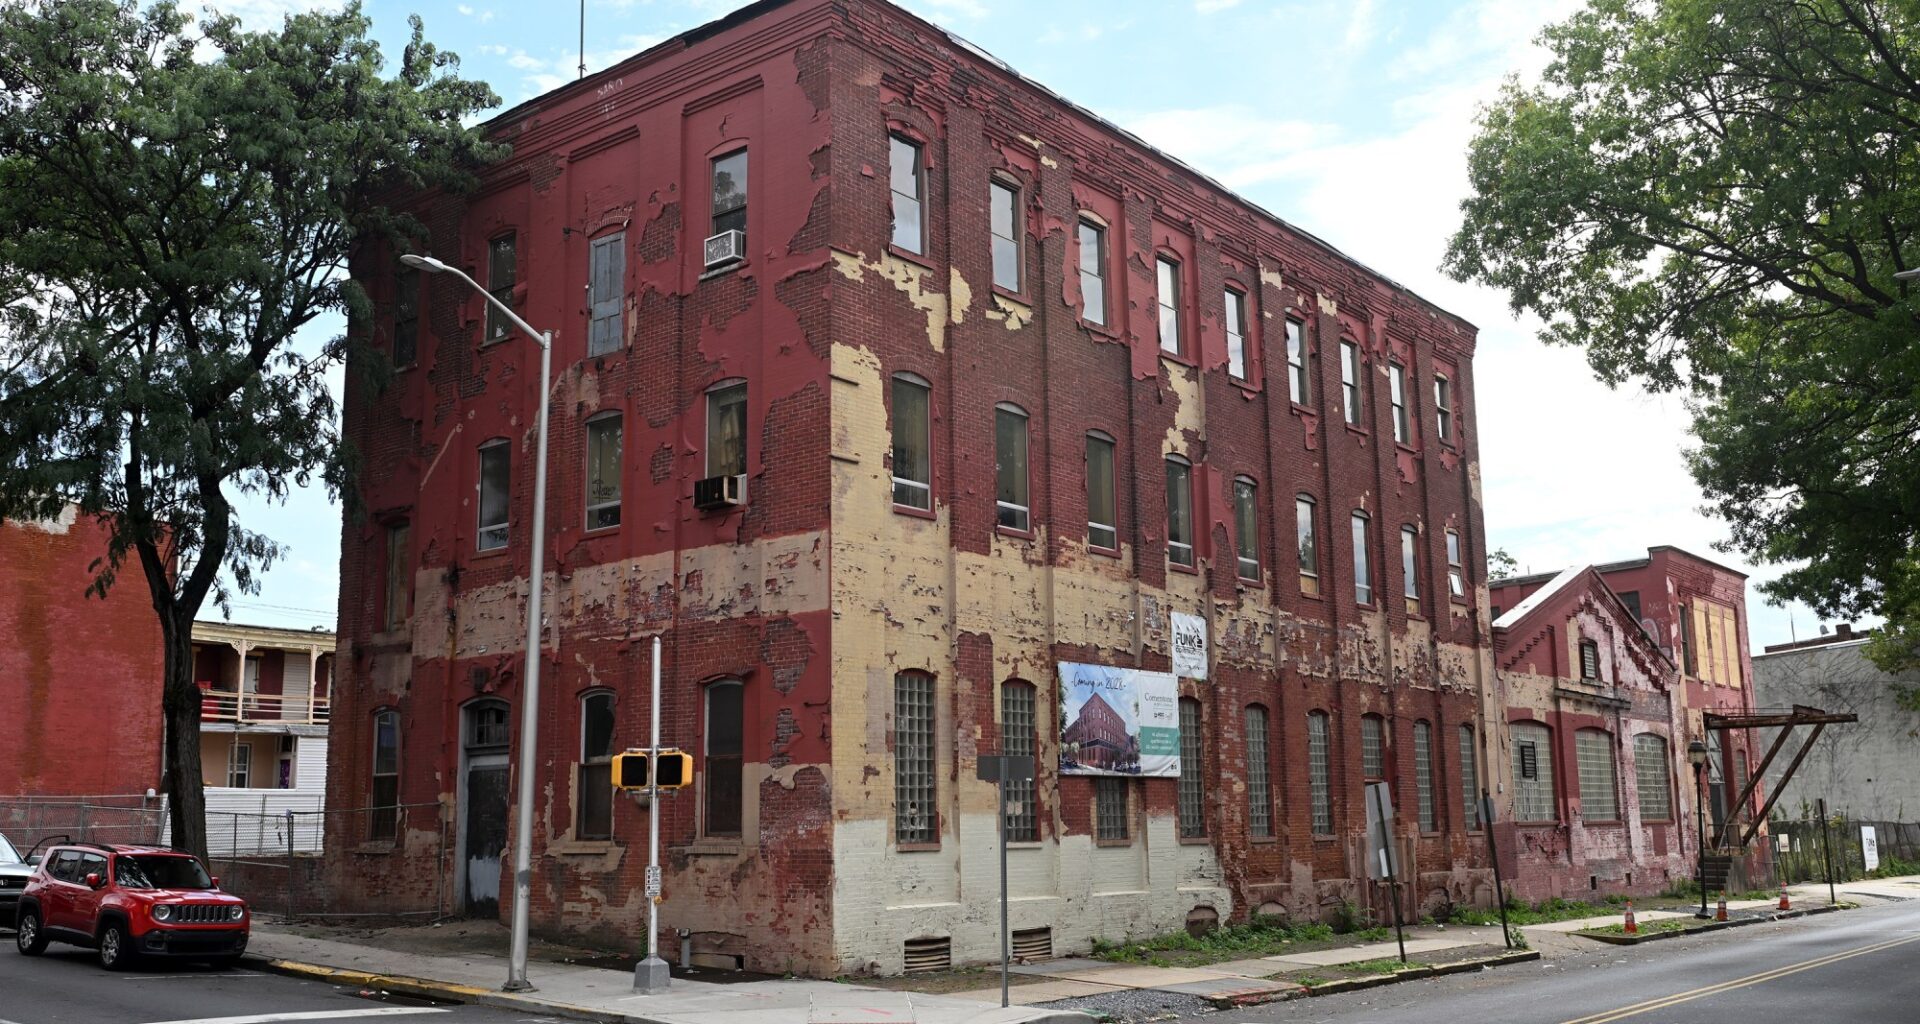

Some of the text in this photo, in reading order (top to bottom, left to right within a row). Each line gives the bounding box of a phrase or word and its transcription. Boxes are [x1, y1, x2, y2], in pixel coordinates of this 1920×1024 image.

[1175, 632, 1197, 648] FUNK
[1073, 671, 1095, 694] Coming
[1096, 679, 1103, 687] in
